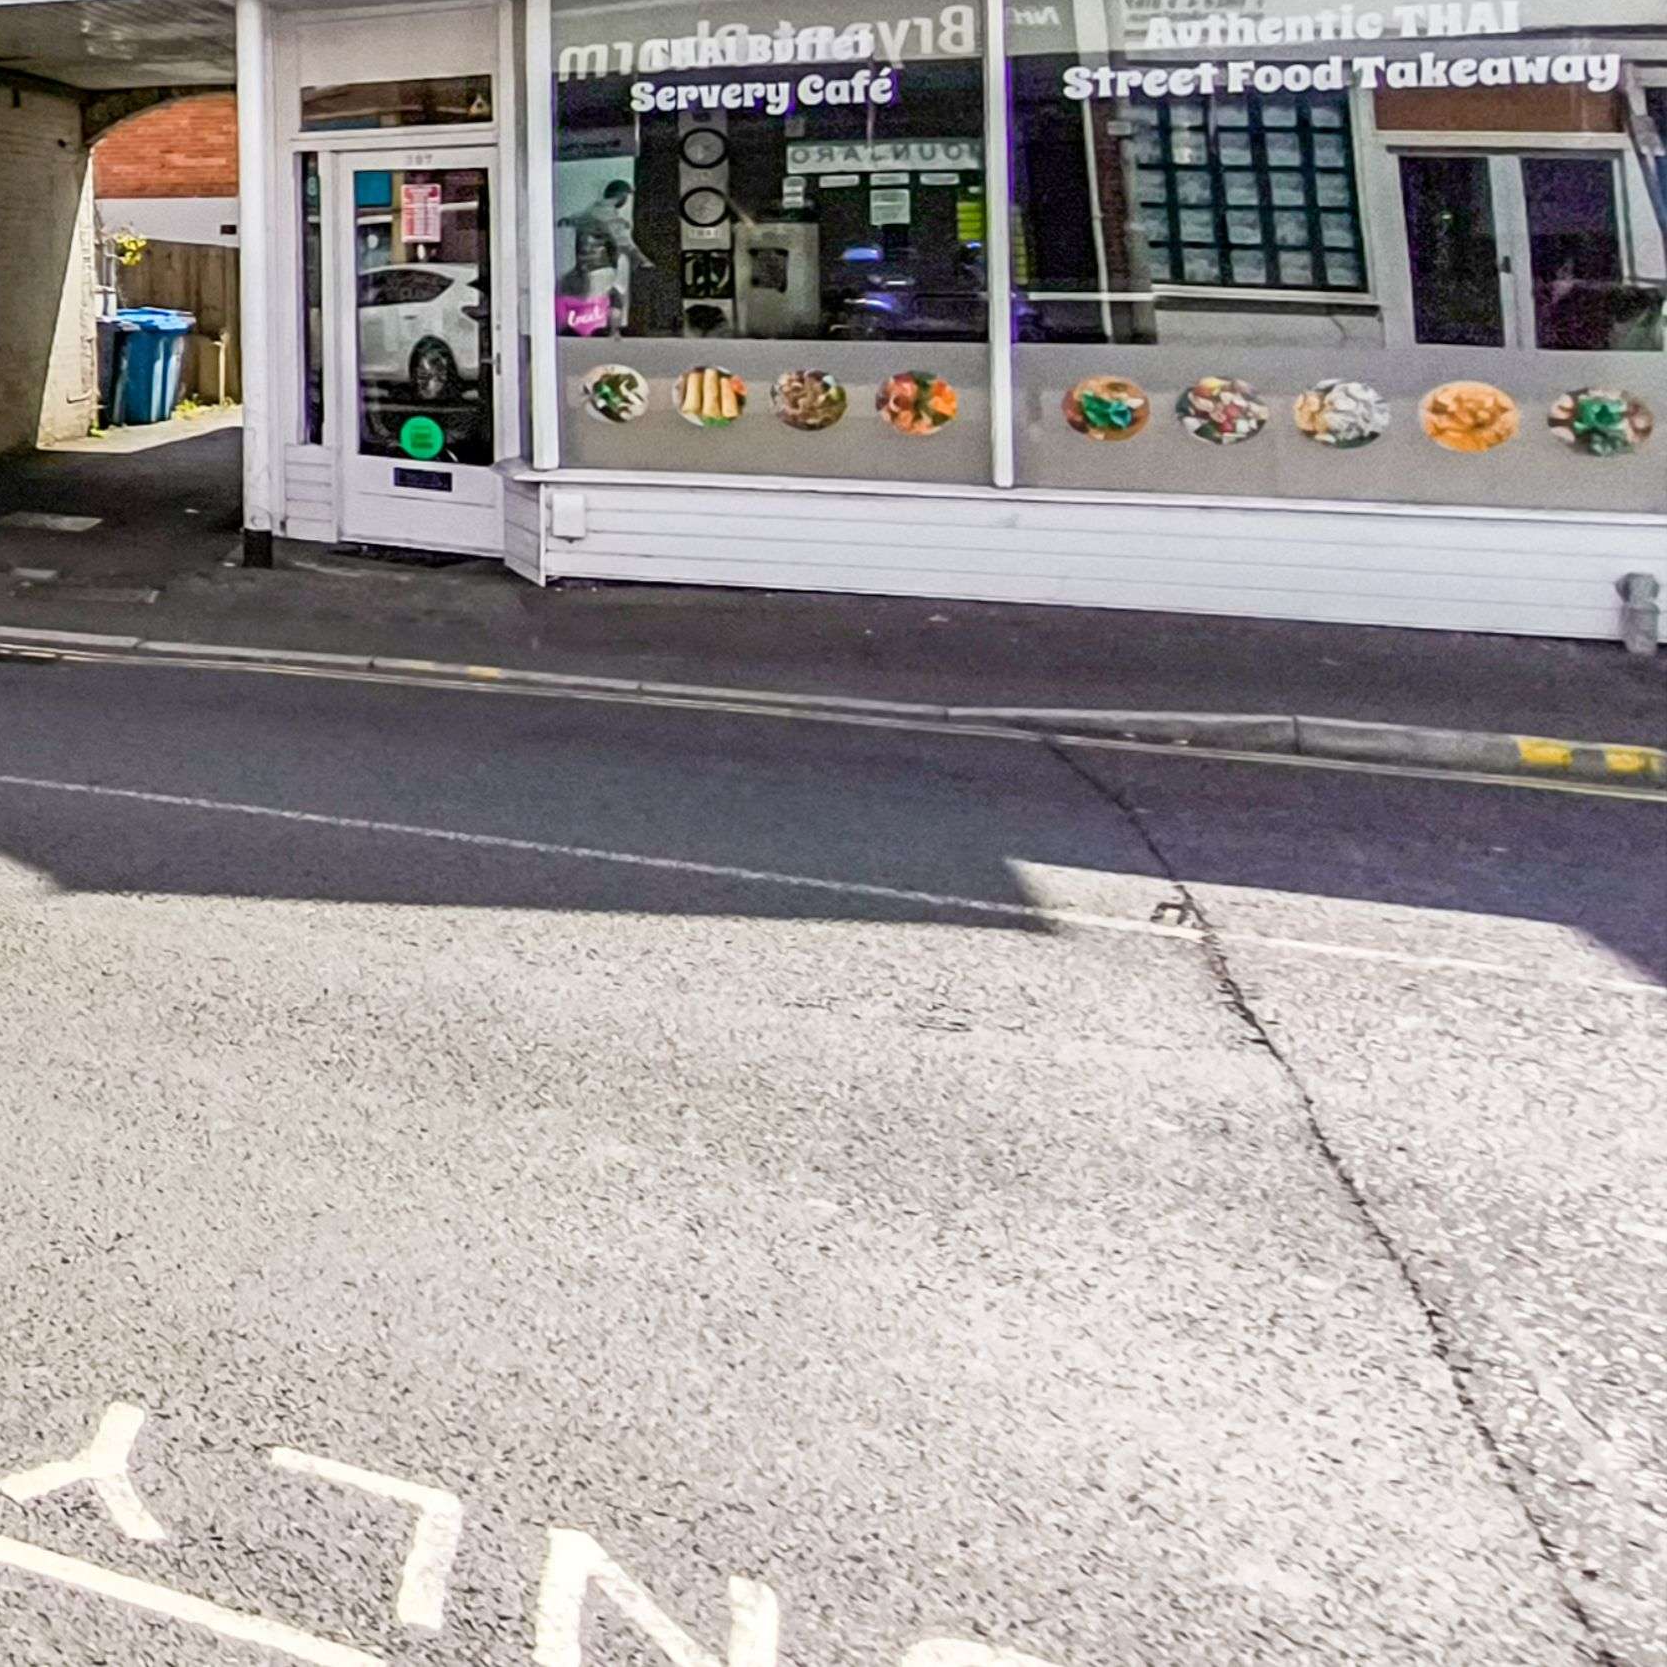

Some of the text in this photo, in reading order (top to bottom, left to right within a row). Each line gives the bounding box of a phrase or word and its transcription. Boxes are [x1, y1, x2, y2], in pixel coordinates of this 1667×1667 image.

[1145, 2, 1383, 49] Authentic
[1394, 0, 1521, 38] THAI
[630, 67, 894, 115] Servery Café
[1062, 51, 1621, 99] Street Food Takeaway
